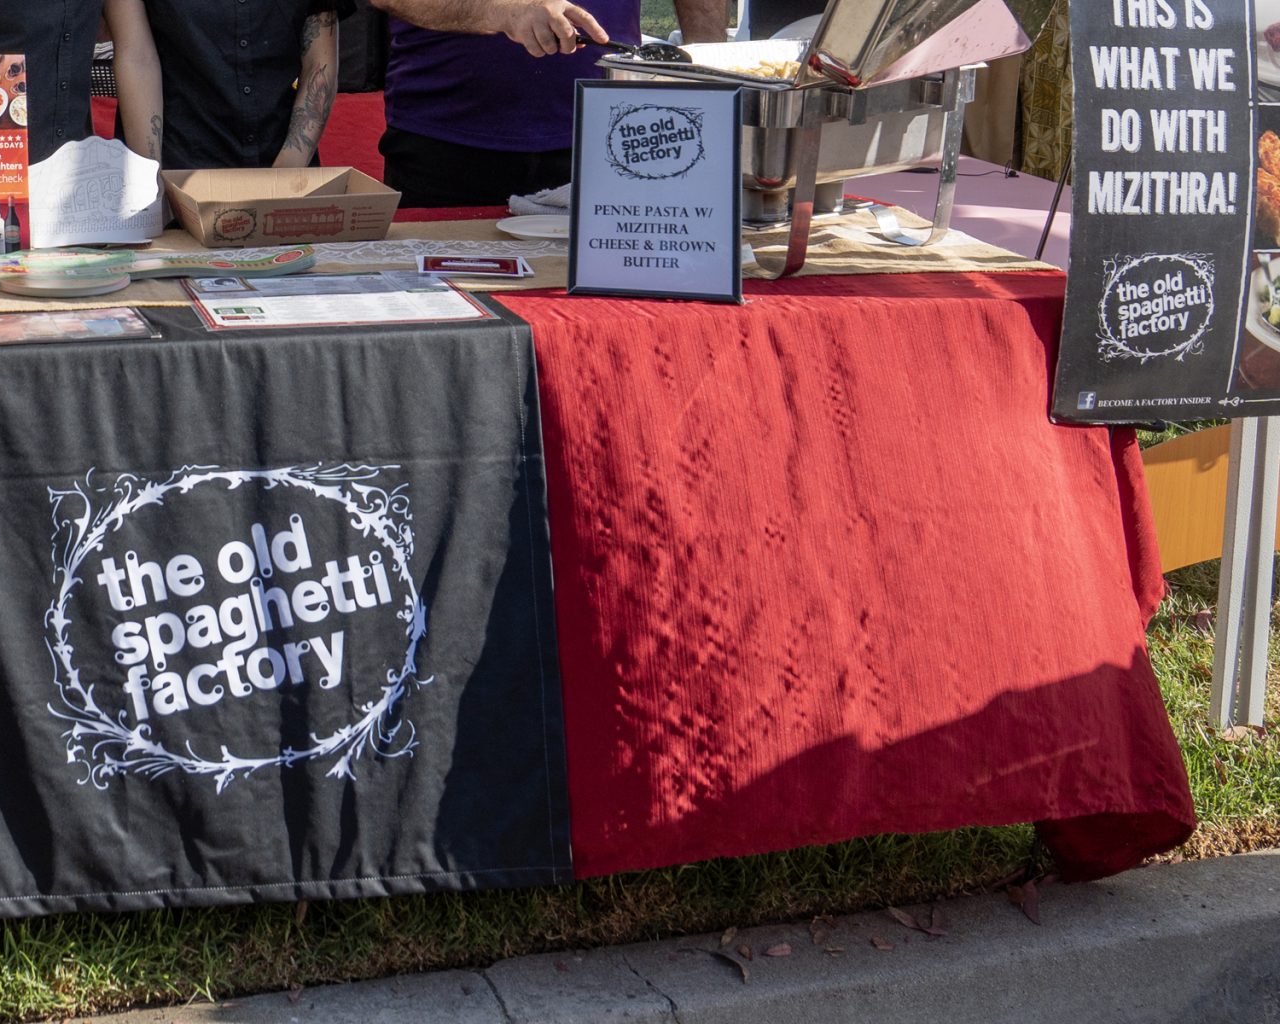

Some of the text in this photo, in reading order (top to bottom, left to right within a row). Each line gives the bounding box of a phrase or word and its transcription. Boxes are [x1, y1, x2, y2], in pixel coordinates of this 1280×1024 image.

[1090, 46, 1235, 92] WHAT WE
[619, 116, 675, 139] the old
[622, 126, 695, 151] spaghetti
[1101, 108, 1228, 154] DO WITH
[624, 145, 682, 165] factory
[1088, 170, 1237, 216] MIZITHRA!
[594, 204, 714, 219] PENNE PASTA W/
[616, 222, 689, 235] MIZITHRA
[589, 238, 716, 253] CHEESE & BROWN
[623, 256, 680, 269] BUTTER
[1116, 270, 1184, 303] the old
[1118, 284, 1208, 324] spaghetti
[1120, 310, 1190, 341] factory
[1098, 399, 1134, 409] BECOME
[1141, 398, 1178, 408] FACTORY
[1179, 396, 1212, 406] INSIDER
[97, 513, 313, 612] the old
[111, 550, 393, 673] spaghetti
[123, 630, 345, 721] factory
